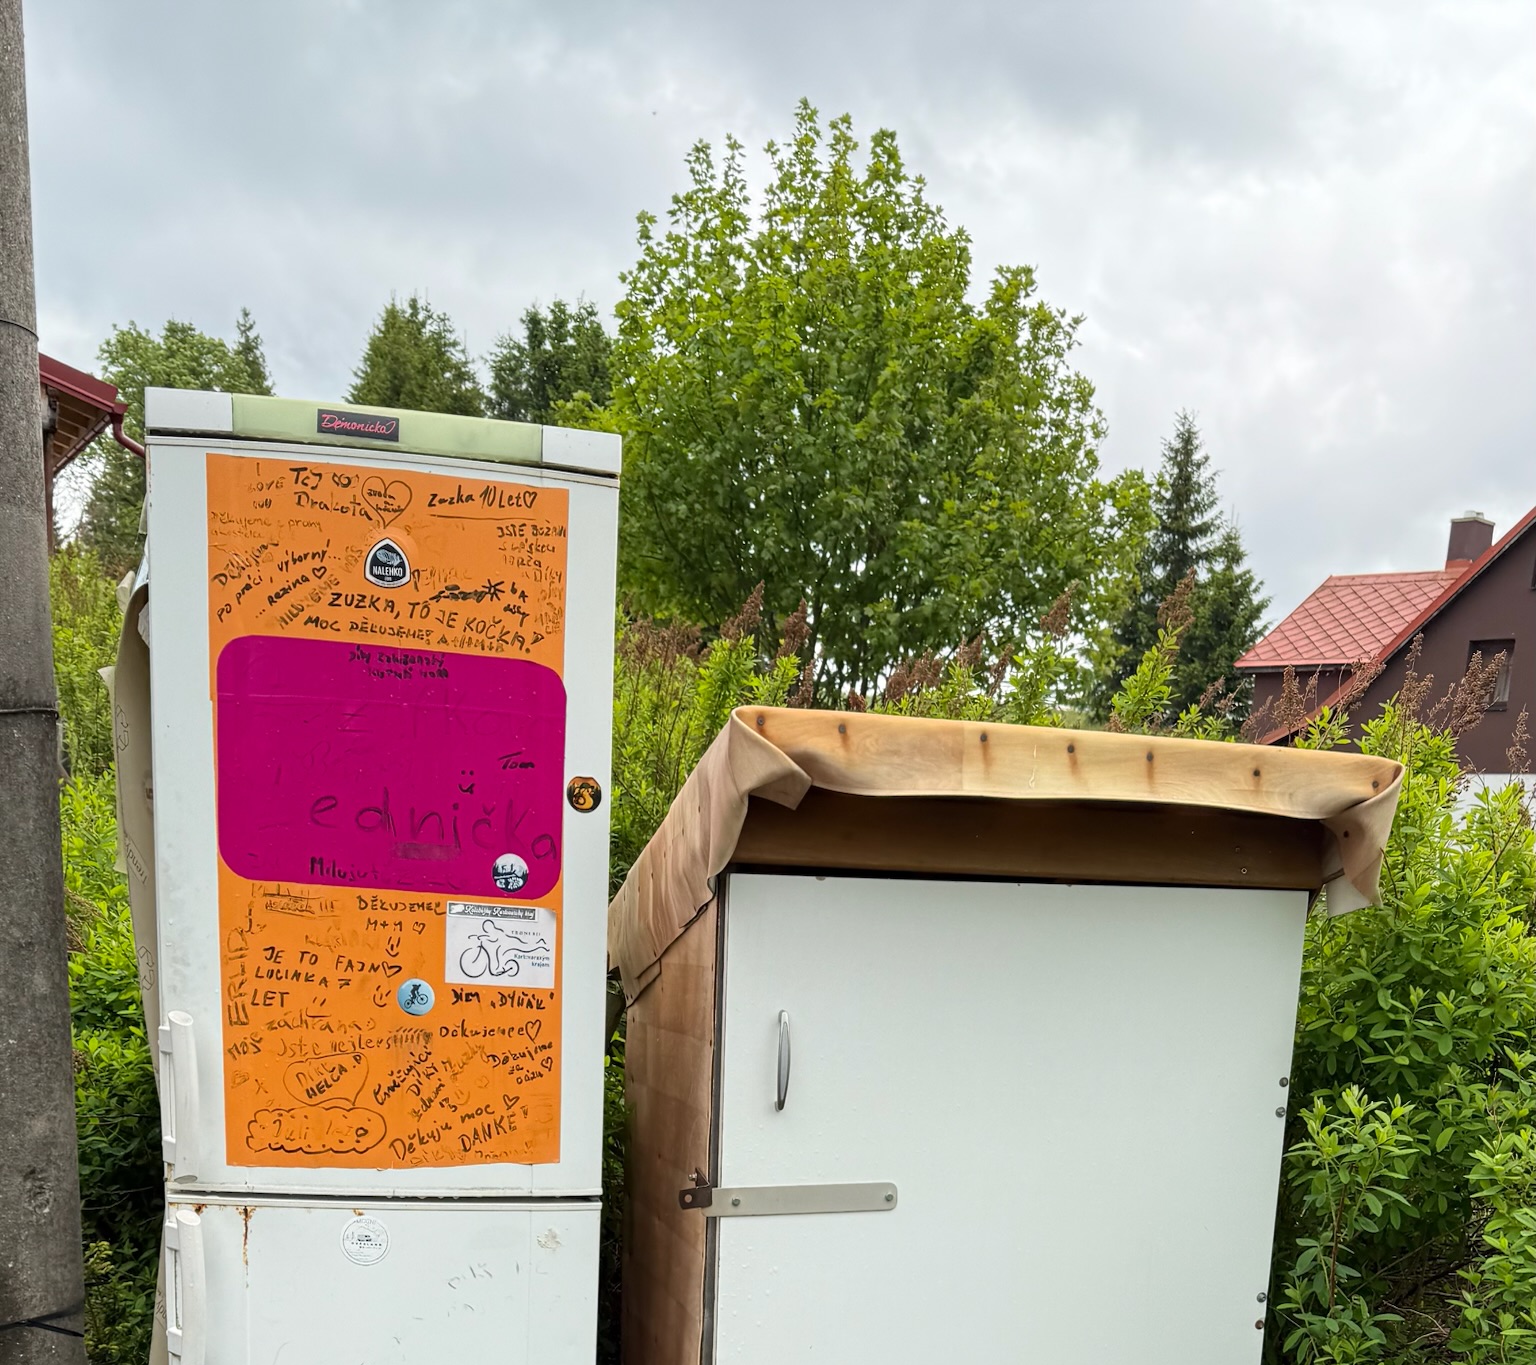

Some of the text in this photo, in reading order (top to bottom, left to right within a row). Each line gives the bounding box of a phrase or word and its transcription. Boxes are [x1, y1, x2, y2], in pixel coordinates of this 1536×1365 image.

[372, 565, 403, 577] NALEHKO
[303, 615, 341, 632] MOC
[263, 946, 285, 964] JE
[299, 951, 319, 966] TO
[251, 989, 290, 1007] LET
